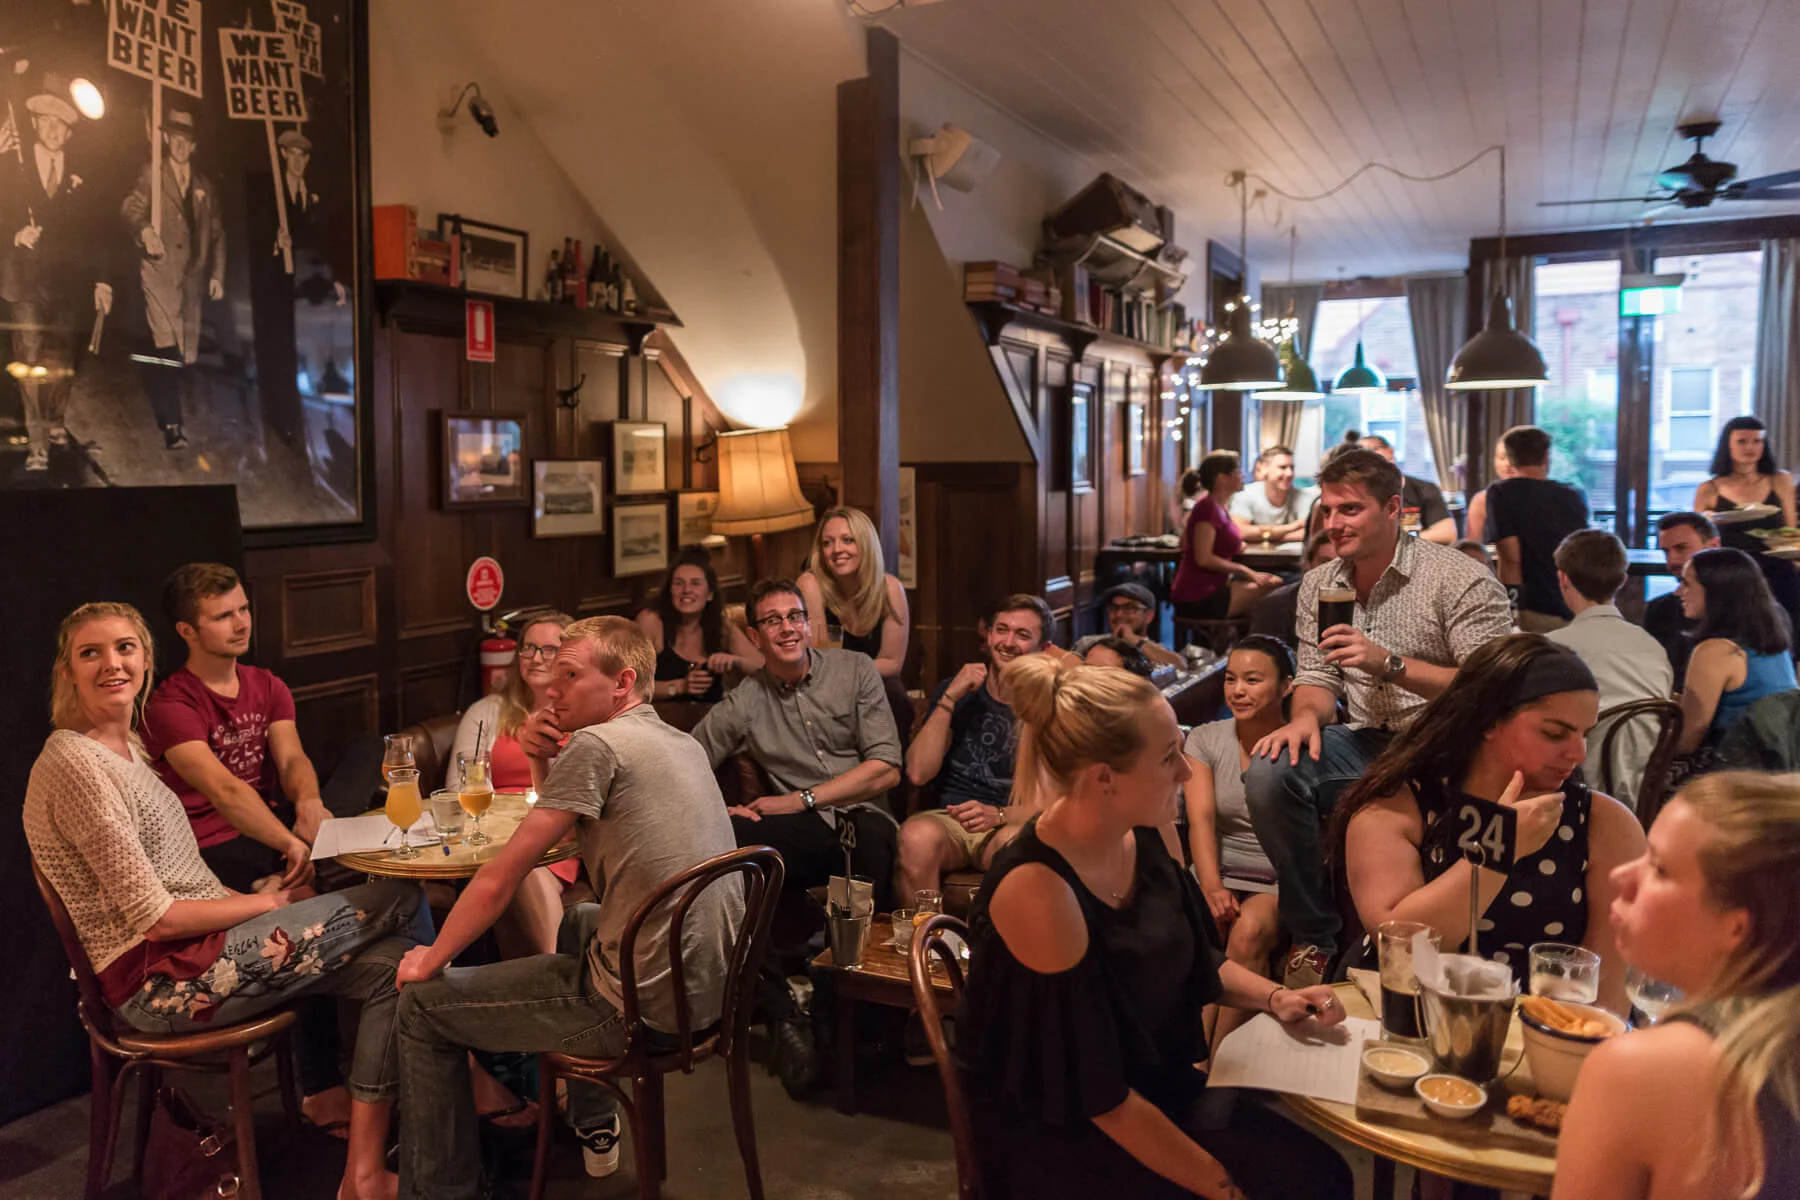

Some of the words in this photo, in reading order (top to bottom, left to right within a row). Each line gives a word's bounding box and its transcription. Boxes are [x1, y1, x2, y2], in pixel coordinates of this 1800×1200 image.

[116, 0, 197, 57] WANT
[112, 31, 197, 91] BEER
[230, 33, 287, 60] WE
[226, 58, 294, 89] WANT
[230, 88, 302, 117] BEER
[838, 817, 857, 849] 28
[1458, 804, 1505, 862] 24
